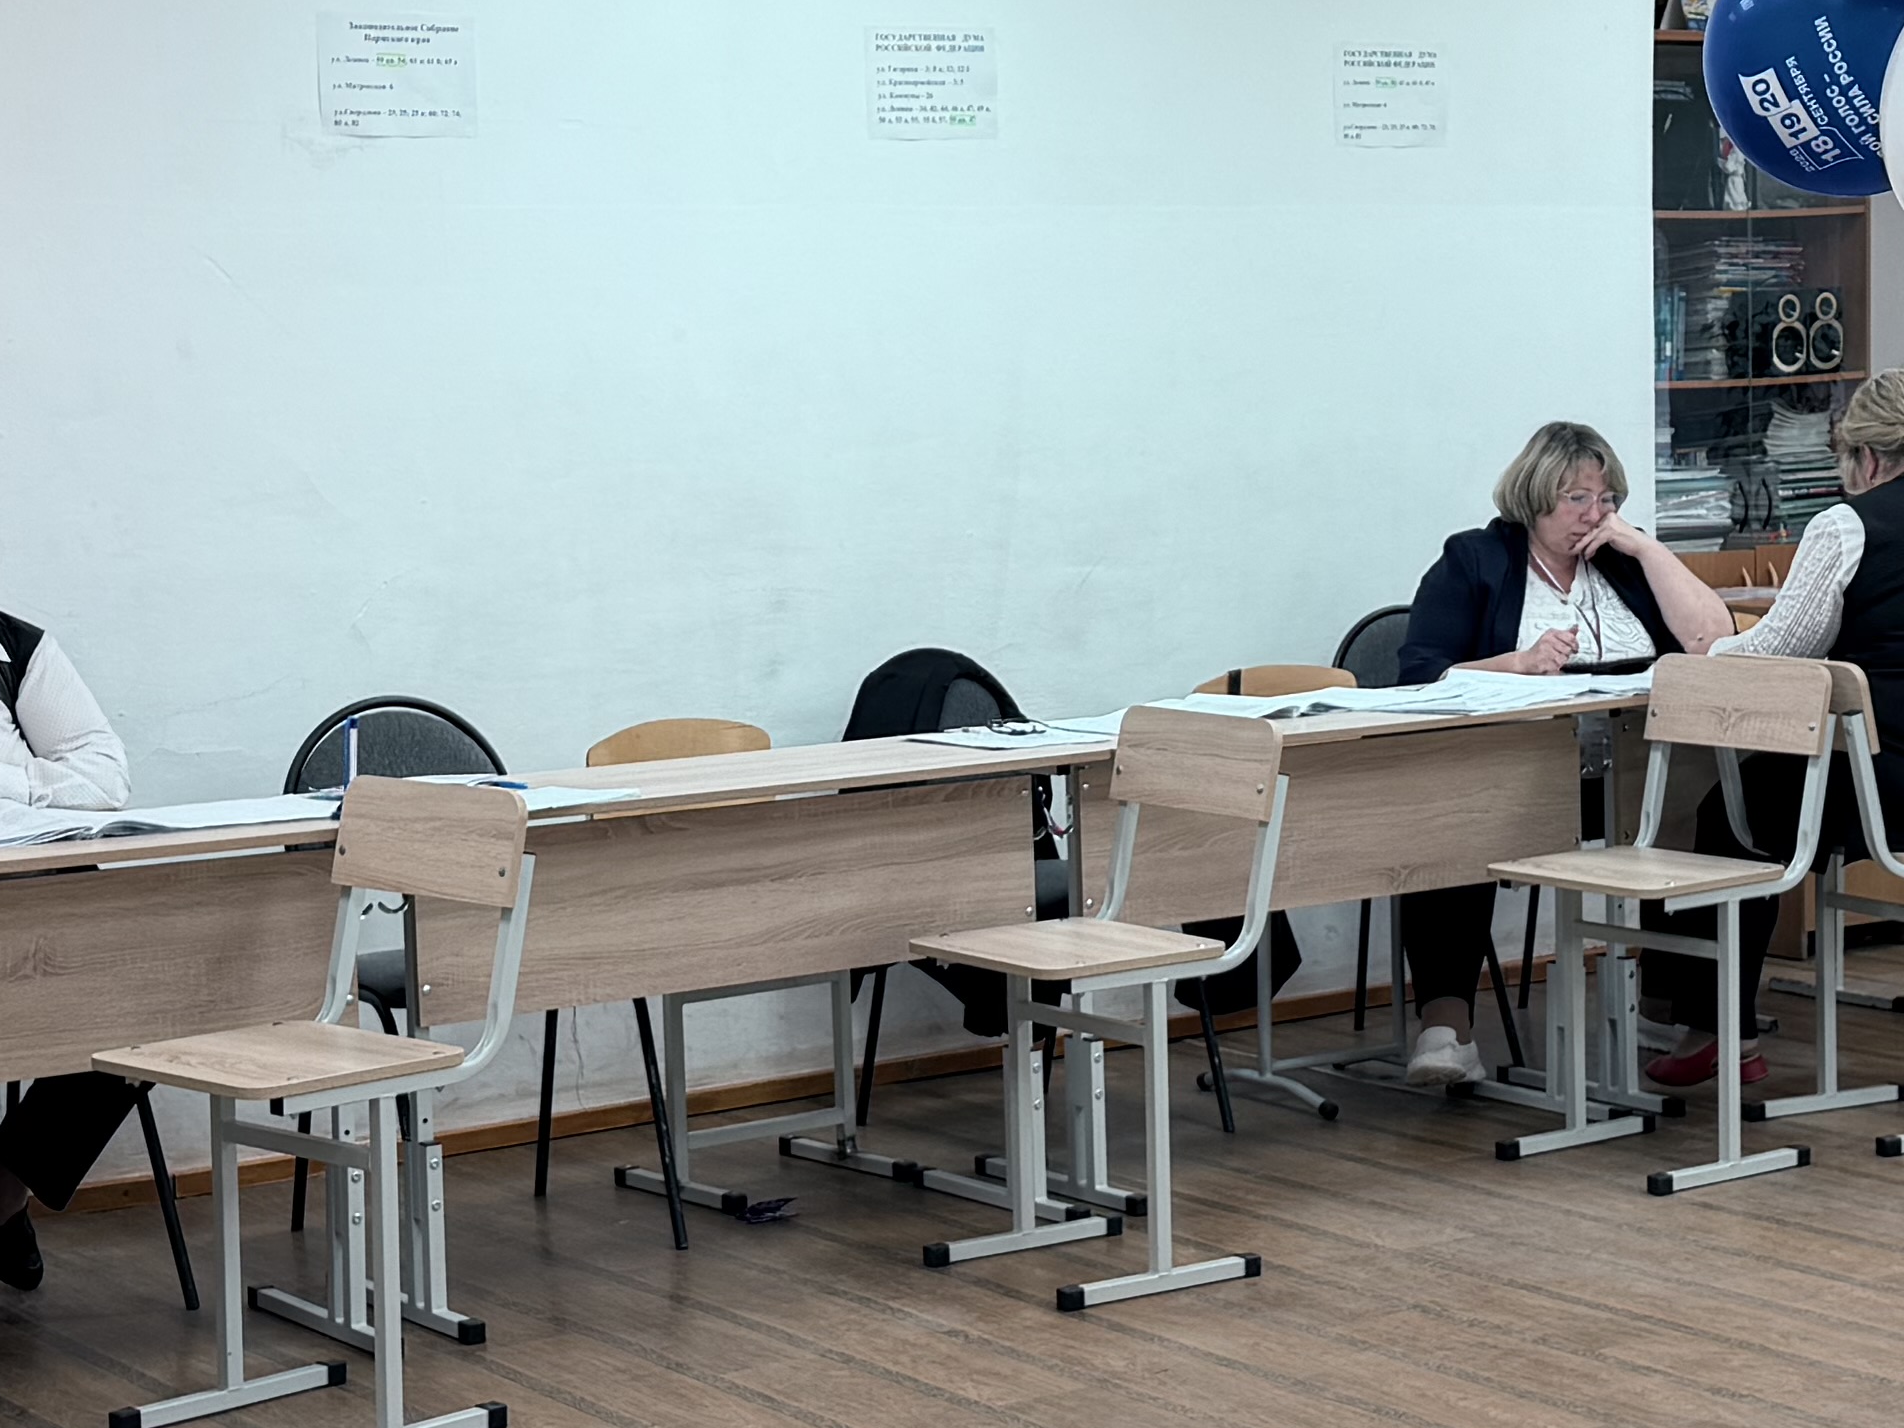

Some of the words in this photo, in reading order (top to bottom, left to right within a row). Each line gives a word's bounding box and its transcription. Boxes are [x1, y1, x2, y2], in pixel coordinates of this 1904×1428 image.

[1815, 14, 1854, 85] РОССИИ
[1752, 78, 1781, 112] 20
[1785, 56, 1828, 125] СЕНТЯБРЯ
[1826, 85, 1866, 134] ГОЛОС
[1848, 84, 1879, 124] СИЛА
[1780, 112, 1808, 140] 19
[1811, 135, 1841, 161] 18
